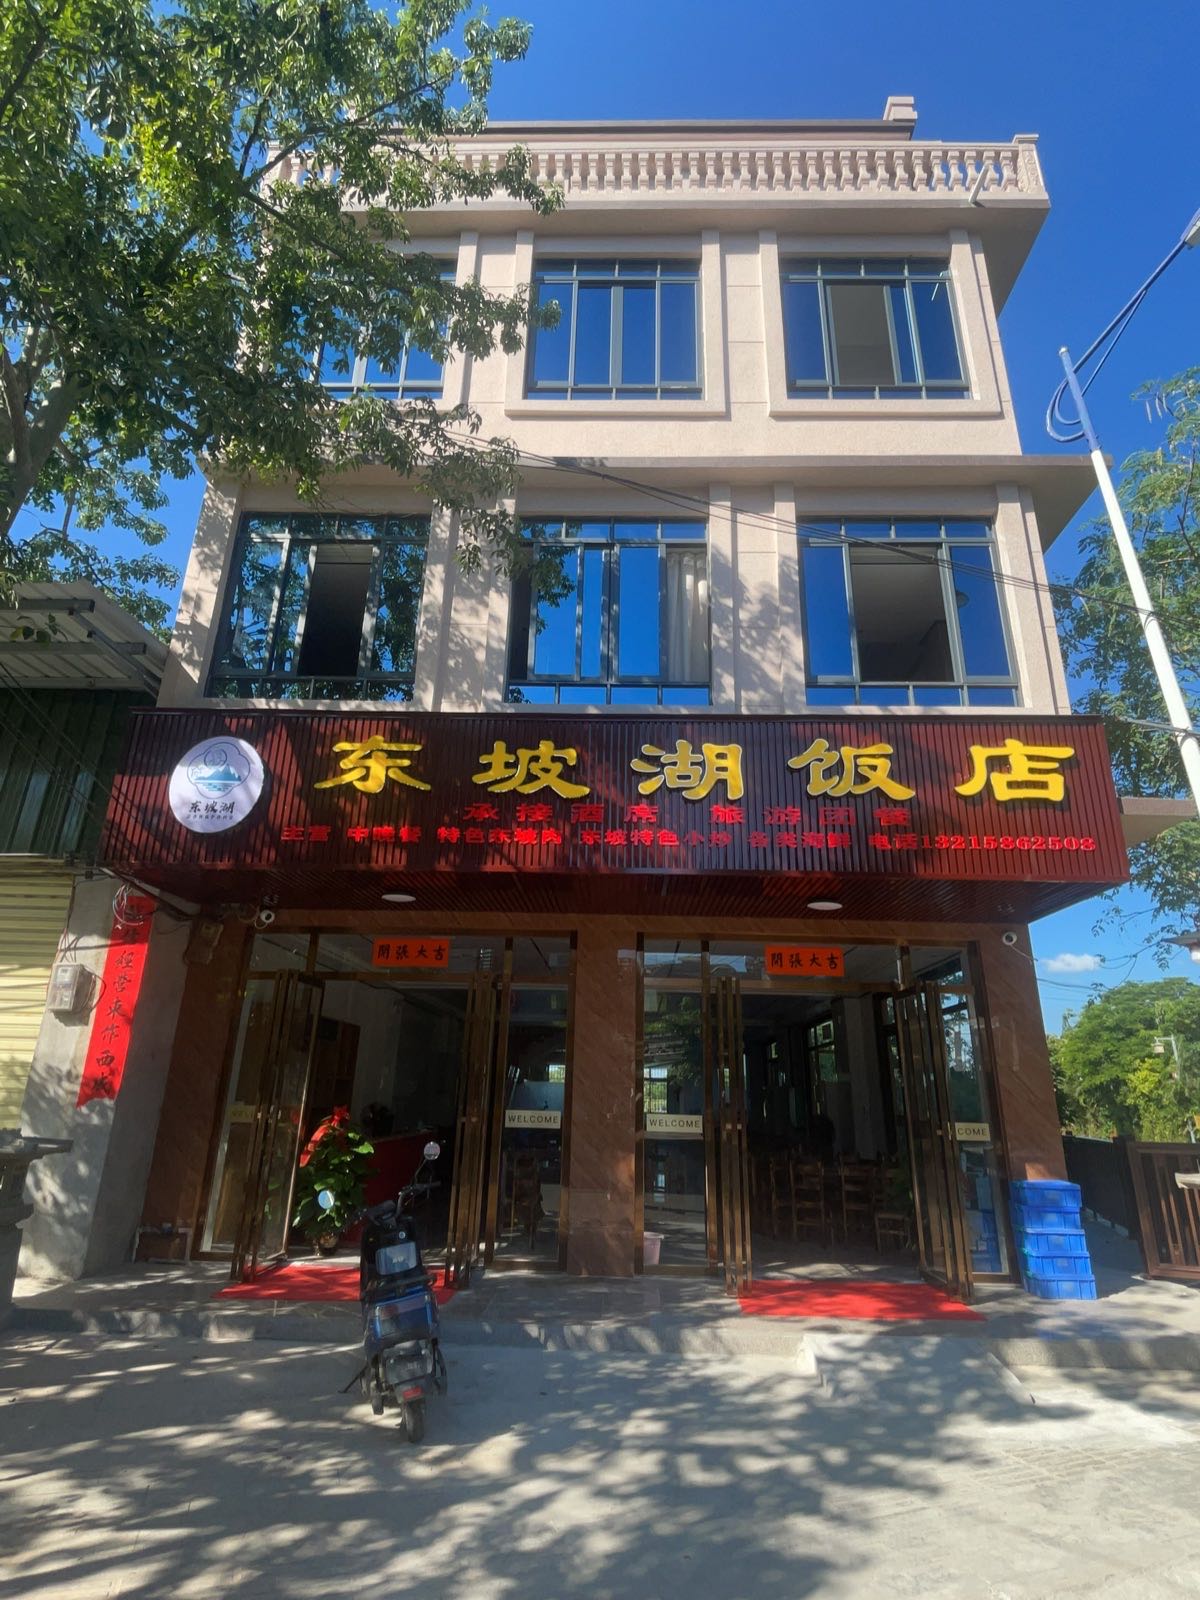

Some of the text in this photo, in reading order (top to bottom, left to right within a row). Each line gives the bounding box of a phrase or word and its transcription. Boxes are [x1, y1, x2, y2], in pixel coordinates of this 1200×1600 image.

[313, 735, 1076, 803] 东坡湖饭店
[188, 800, 236, 814] 东坡湖
[280, 825, 332, 843] 主营
[437, 826, 563, 846] 特色东坡肉
[507, 1114, 559, 1124] WELCOME
[649, 1118, 701, 1129] WELCOME
